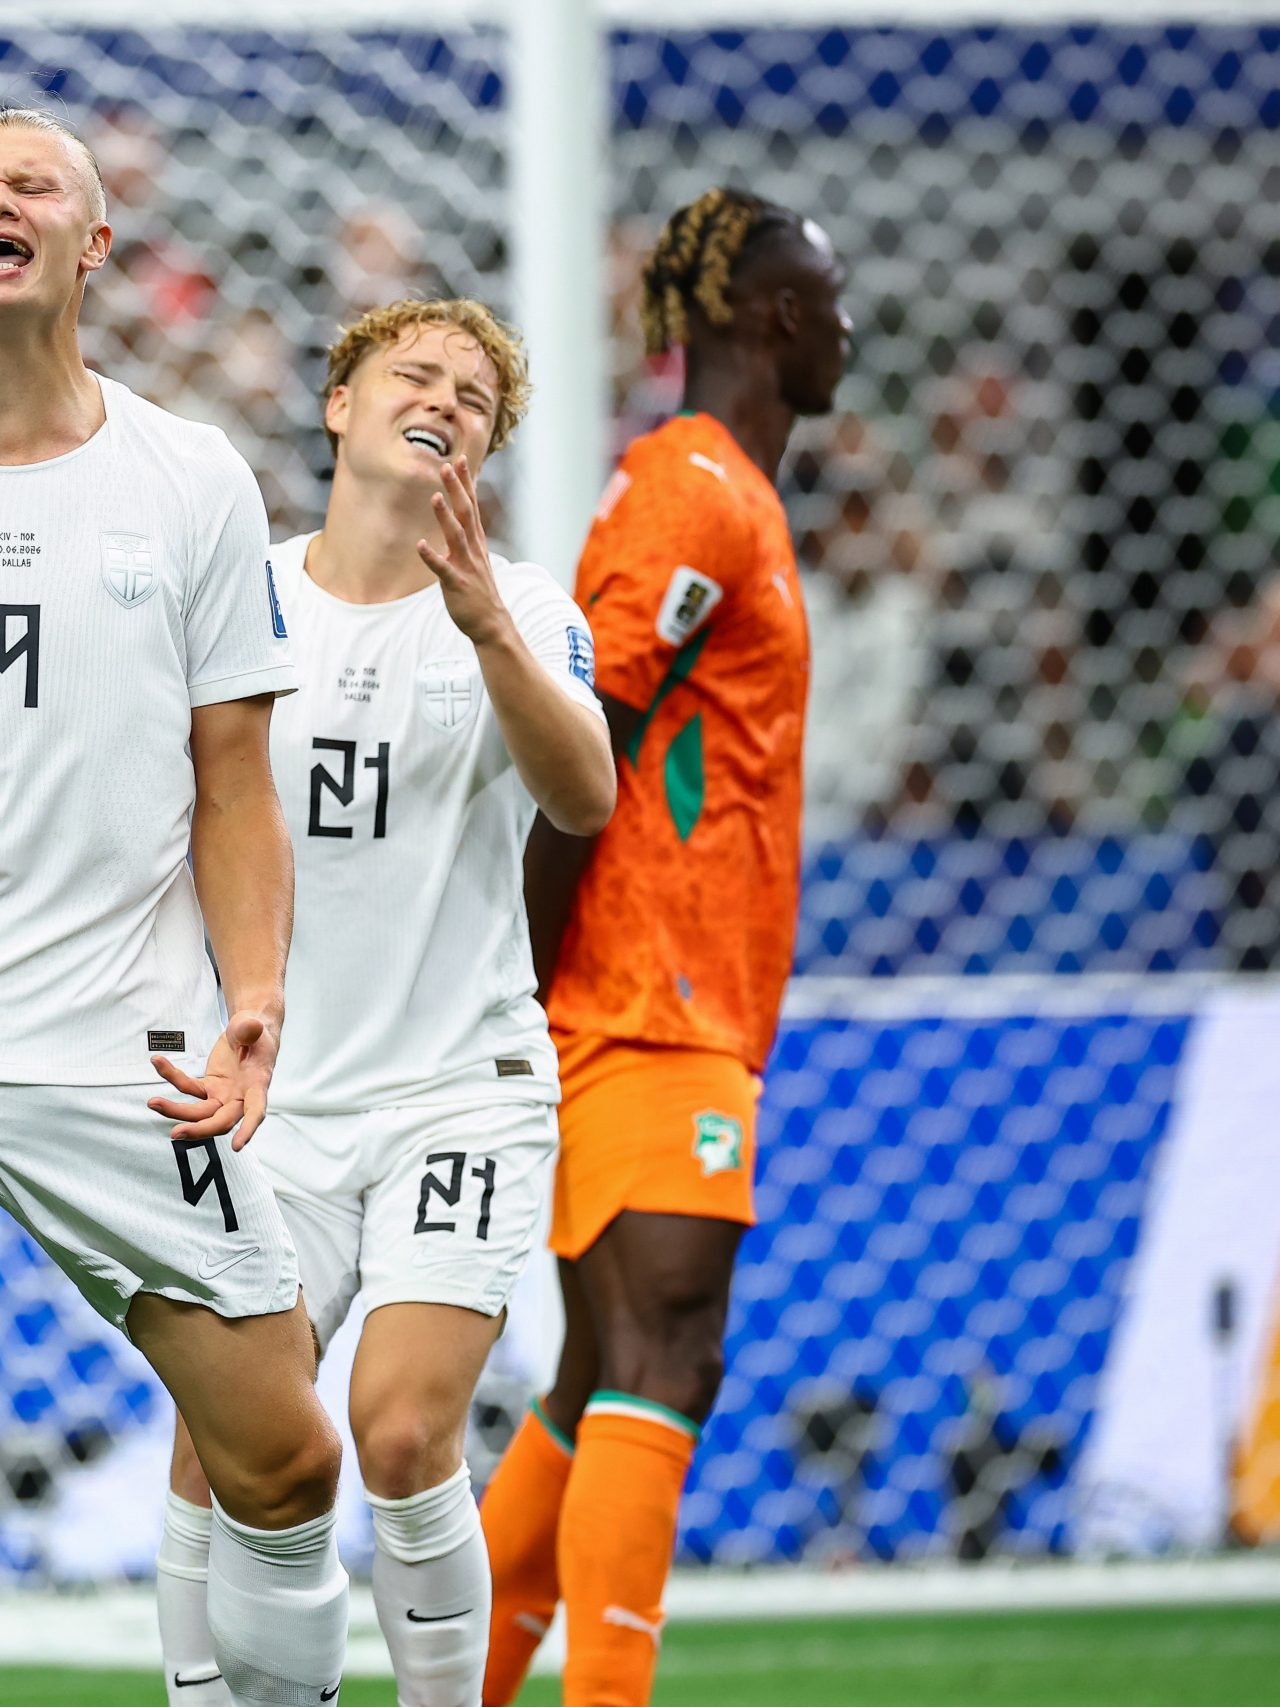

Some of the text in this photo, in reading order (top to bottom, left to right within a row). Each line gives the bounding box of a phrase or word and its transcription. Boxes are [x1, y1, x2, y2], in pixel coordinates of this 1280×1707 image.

[1, 558, 32, 567] DALLAS
[20, 532, 35, 541] NOR
[308, 737, 390, 839] 21
[171, 1137, 239, 1233] 9
[414, 1152, 496, 1241] 21
